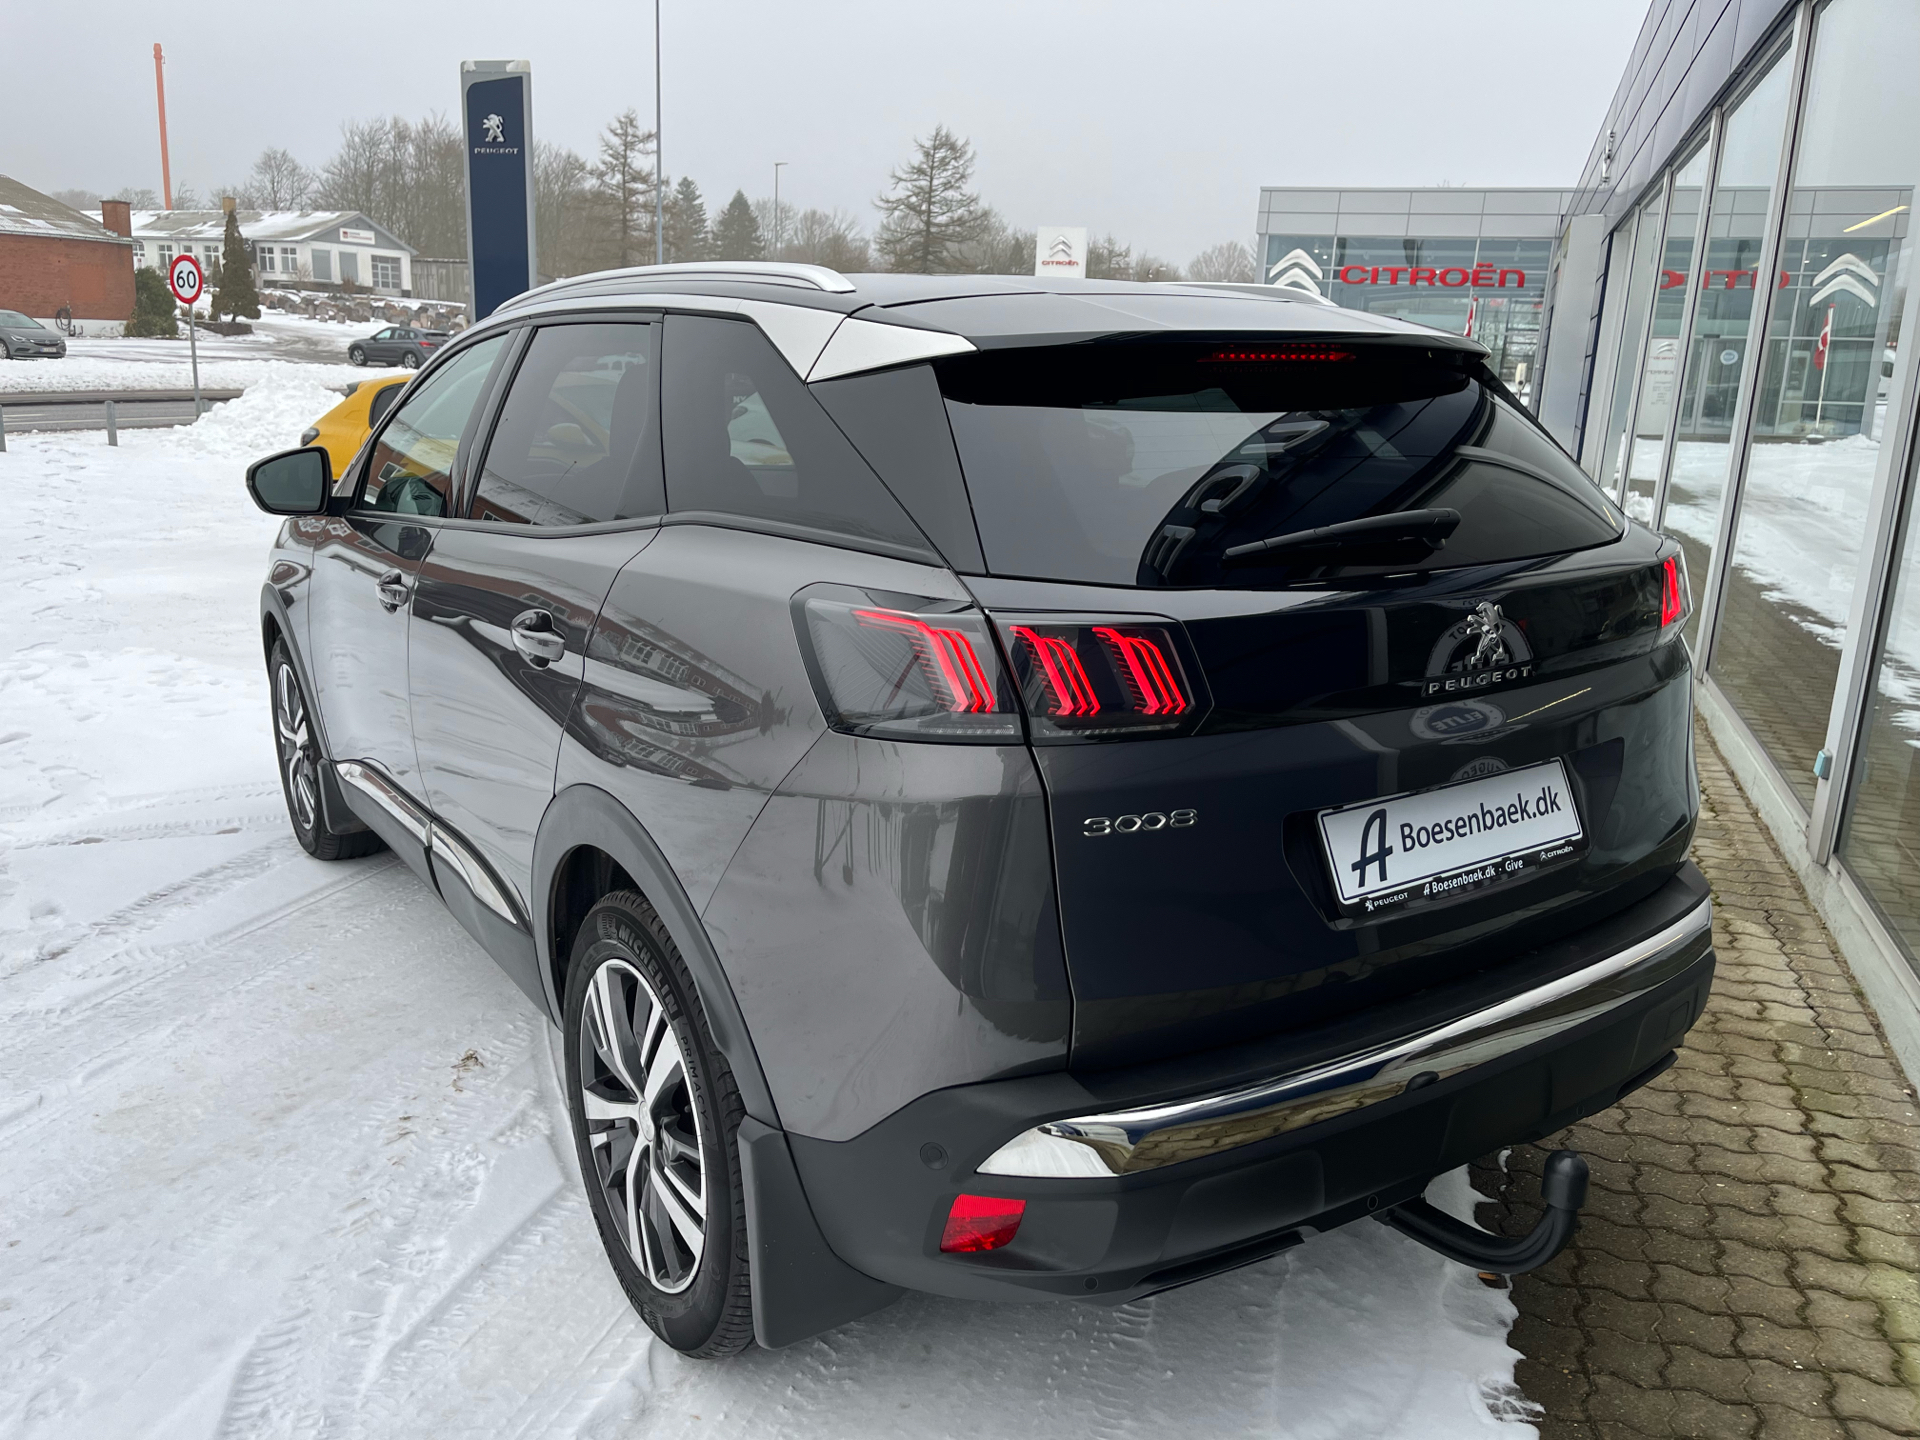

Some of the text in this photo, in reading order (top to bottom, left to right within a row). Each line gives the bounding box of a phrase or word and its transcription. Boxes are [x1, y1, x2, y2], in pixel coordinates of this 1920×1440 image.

[176, 270, 197, 289] 60
[1428, 665, 1533, 694] PEUGEOT
[1083, 808, 1199, 837] 3008
[1351, 785, 1562, 889] A Boesenbaek.dk
[1432, 865, 1496, 893] Boesenbaek.dk
[1505, 859, 1524, 872] Give
[1374, 891, 1409, 907] PEUGEOT
[618, 923, 679, 1014] MICHELIN
[680, 1035, 709, 1120] PRIMACY
